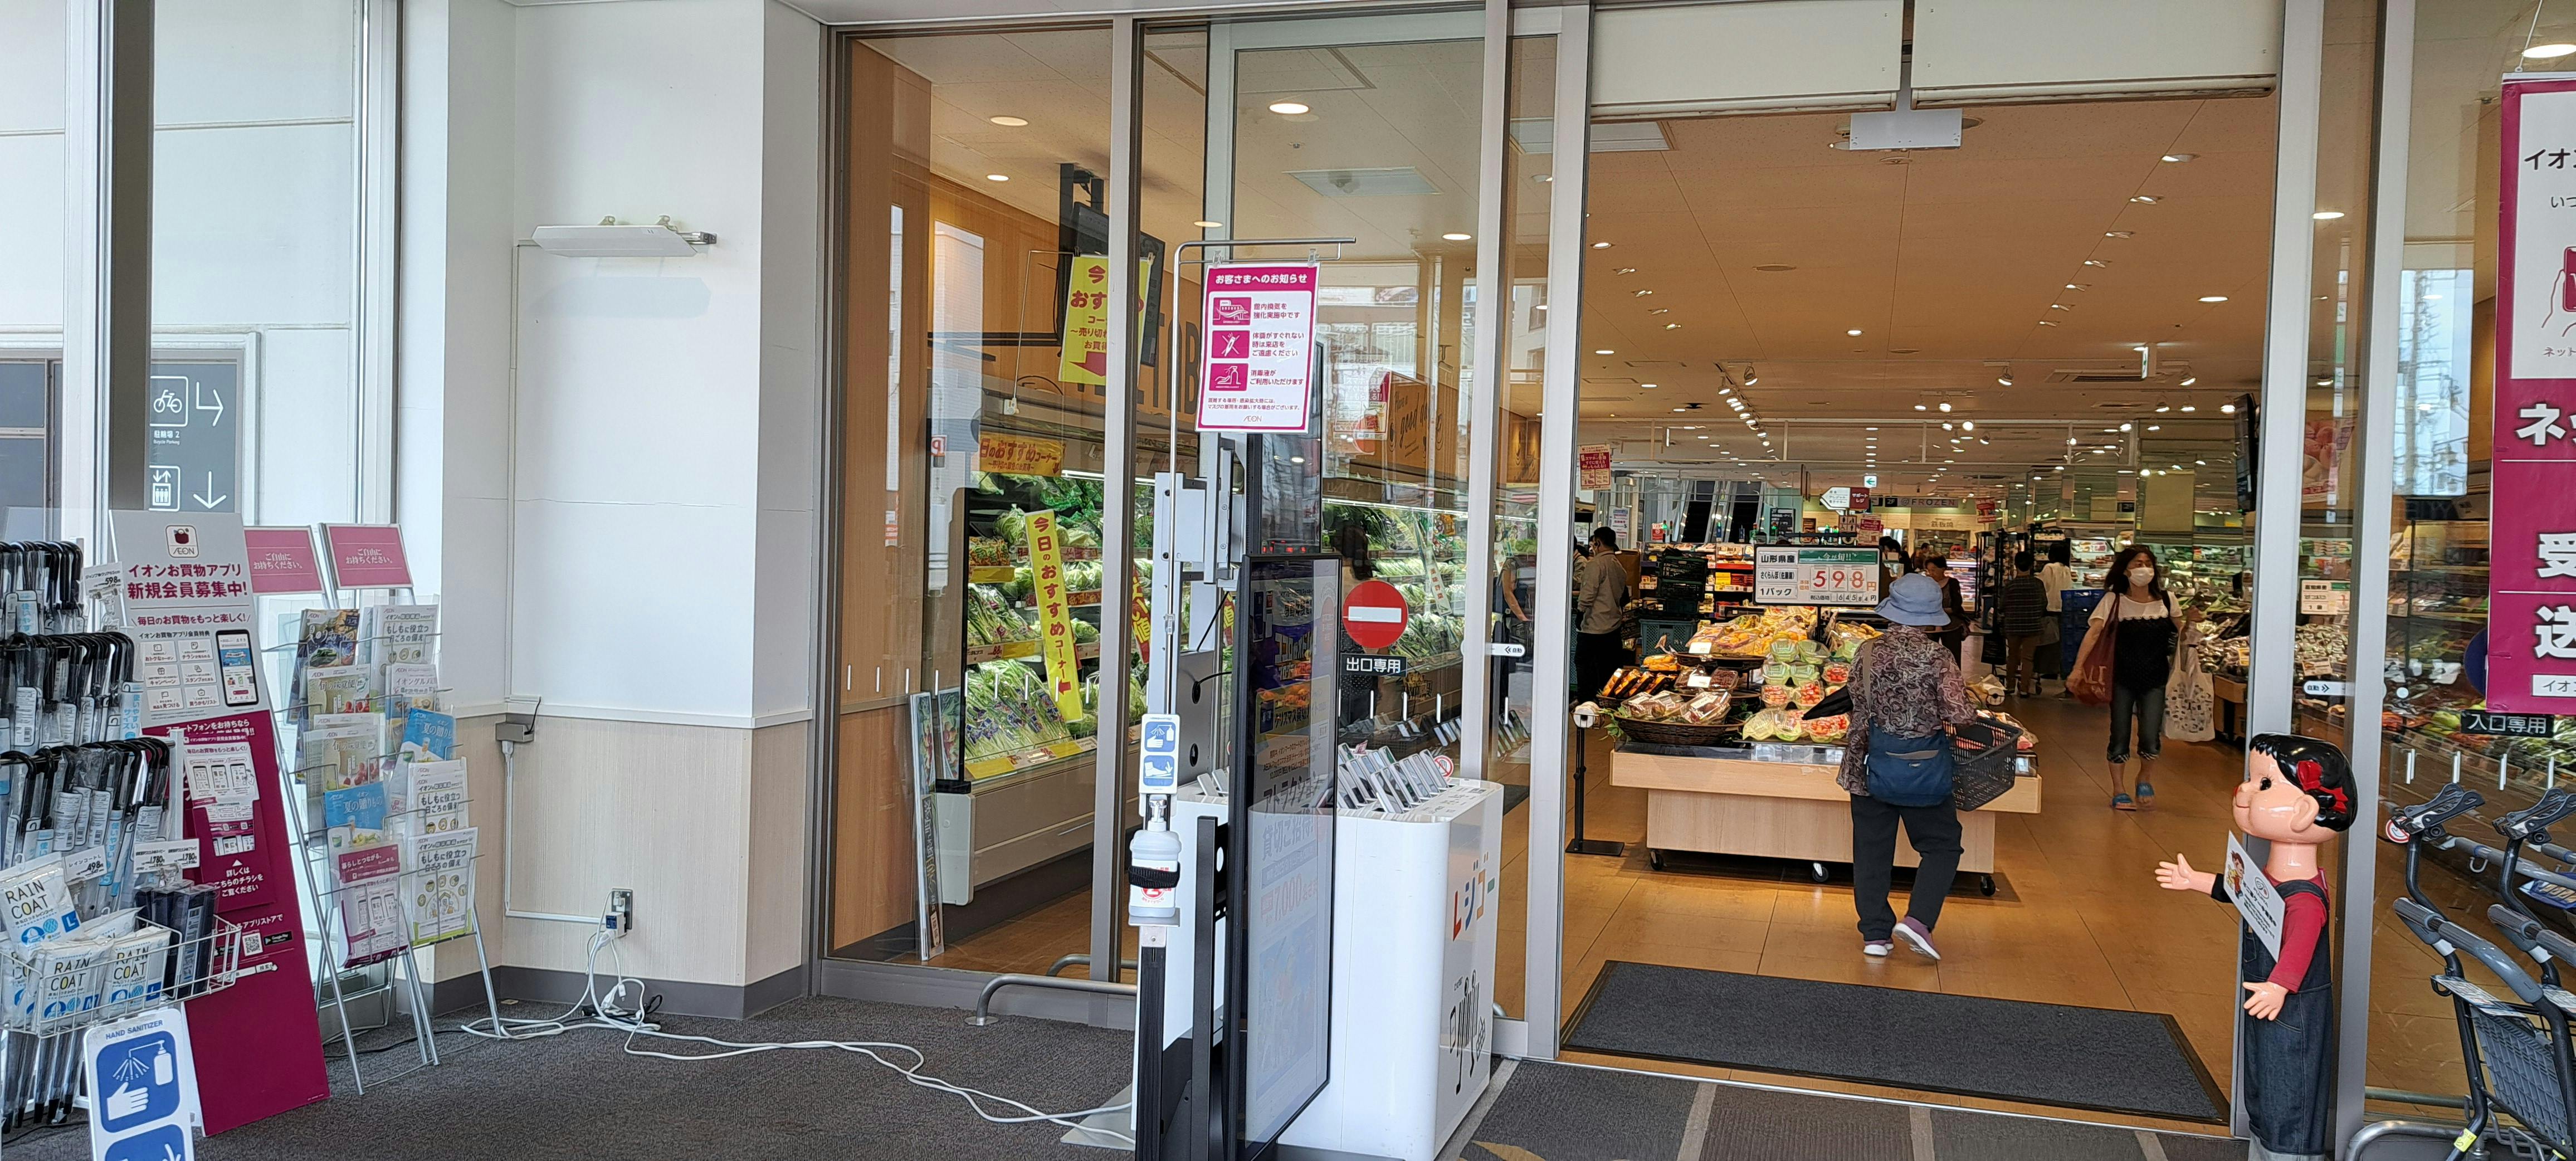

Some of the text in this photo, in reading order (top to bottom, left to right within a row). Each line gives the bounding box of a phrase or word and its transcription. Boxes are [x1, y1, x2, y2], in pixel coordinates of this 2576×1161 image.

[2524, 148, 2576, 170] イオ
[1216, 274, 1307, 285] お客さまへのお知らせ
[2515, 403, 2576, 446] ネ
[1761, 555, 1795, 563] 山形県産
[129, 563, 241, 577] イオンお買物アプリ
[128, 581, 248, 599] 新規会員募集中!
[1033, 516, 1067, 680] 今日のおすすめコーナー
[137, 613, 246, 626] 毎日のお買物をもっと楽しく!
[139, 631, 211, 639] イオンお買物アプリ会員特典
[1345, 658, 1401, 673] 出口専用
[165, 719, 250, 733] スートフォンをお持ちなら
[2467, 714, 2546, 735] 入口専用
[421, 792, 461, 806] もしもに役立つ
[421, 850, 467, 864] もしもに役立つ
[226, 866, 250, 877] 詳しくは
[214, 874, 264, 889] こちらのチラシを
[5, 880, 45, 904] RAIN
[222, 885, 259, 897] ご覧ください
[1453, 851, 1496, 942] レジゴー
[11, 894, 48, 919] COAT
[54, 958, 91, 974] RAIN
[114, 962, 147, 979] COAT
[51, 973, 86, 991] COAT
[105, 1019, 163, 1040] HAND SANITIZER
